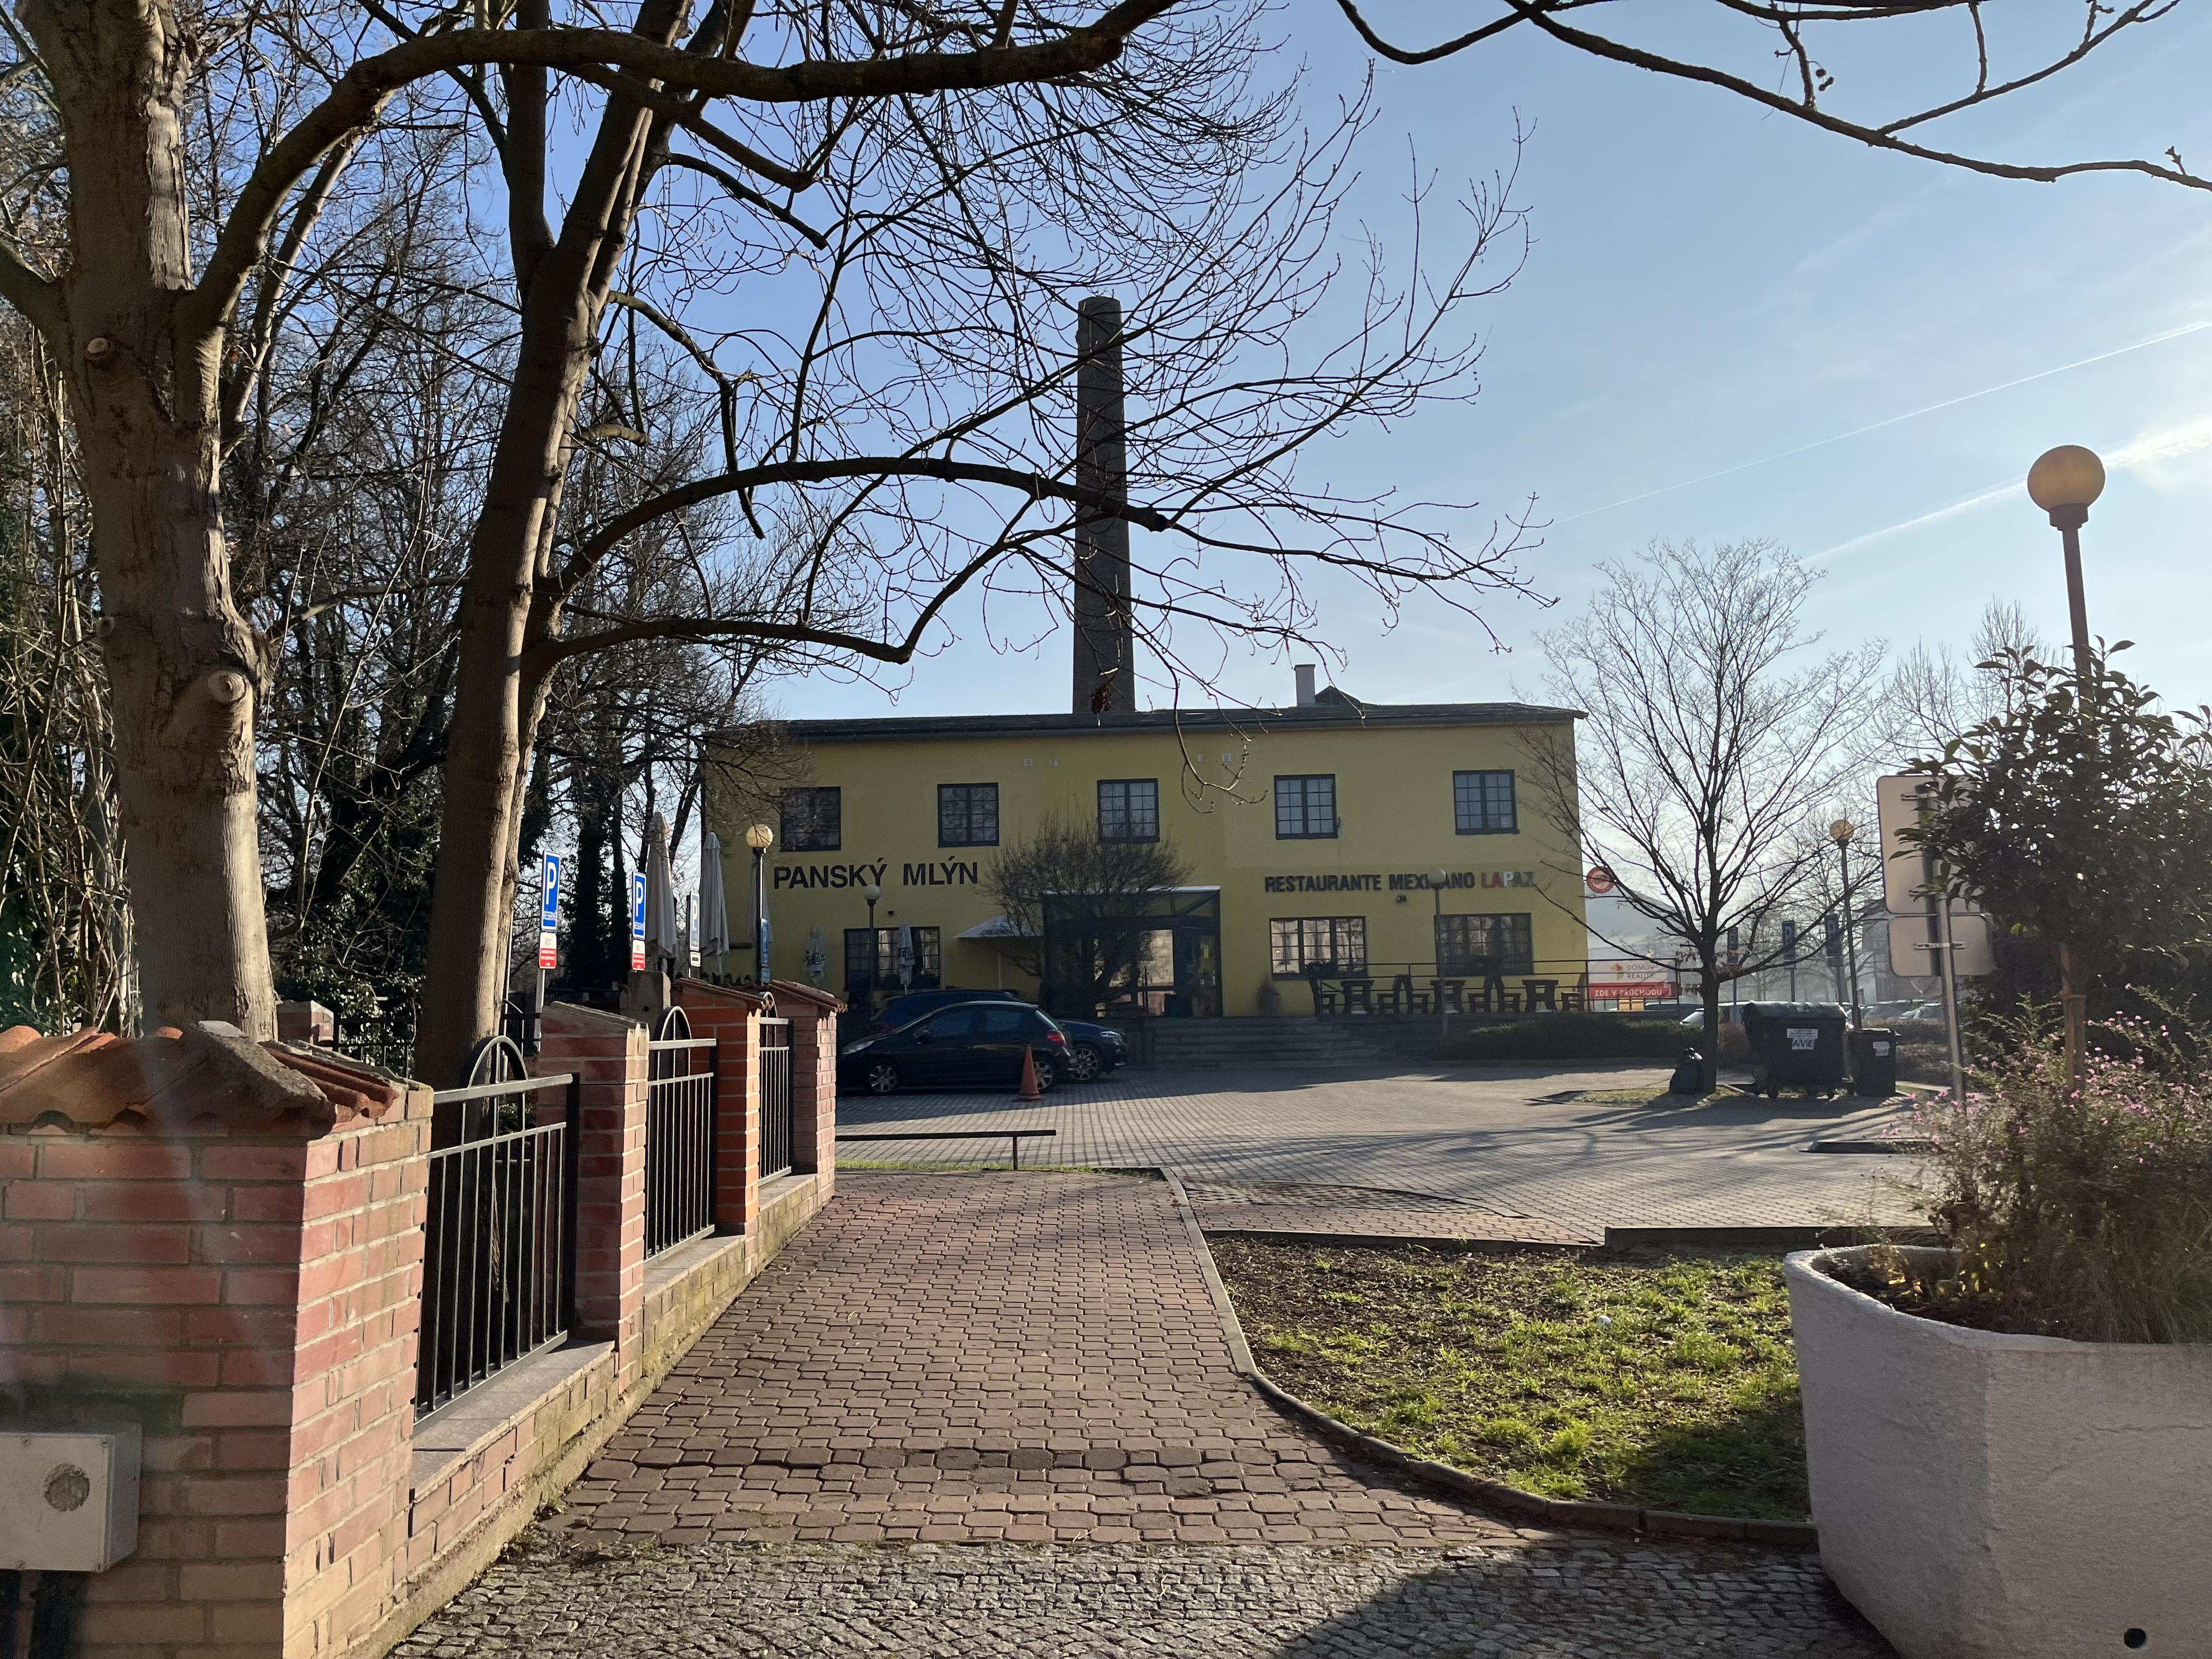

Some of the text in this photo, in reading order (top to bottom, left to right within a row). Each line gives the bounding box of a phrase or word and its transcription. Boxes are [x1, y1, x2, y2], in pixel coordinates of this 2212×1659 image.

[546, 862, 557, 905] P
[774, 855, 978, 889] PANSKÝ MLÝN
[1265, 874, 1382, 892] RESTAURANTE
[1389, 872, 1475, 890] MEXIANO
[635, 881, 643, 917] P
[692, 899, 698, 931] P
